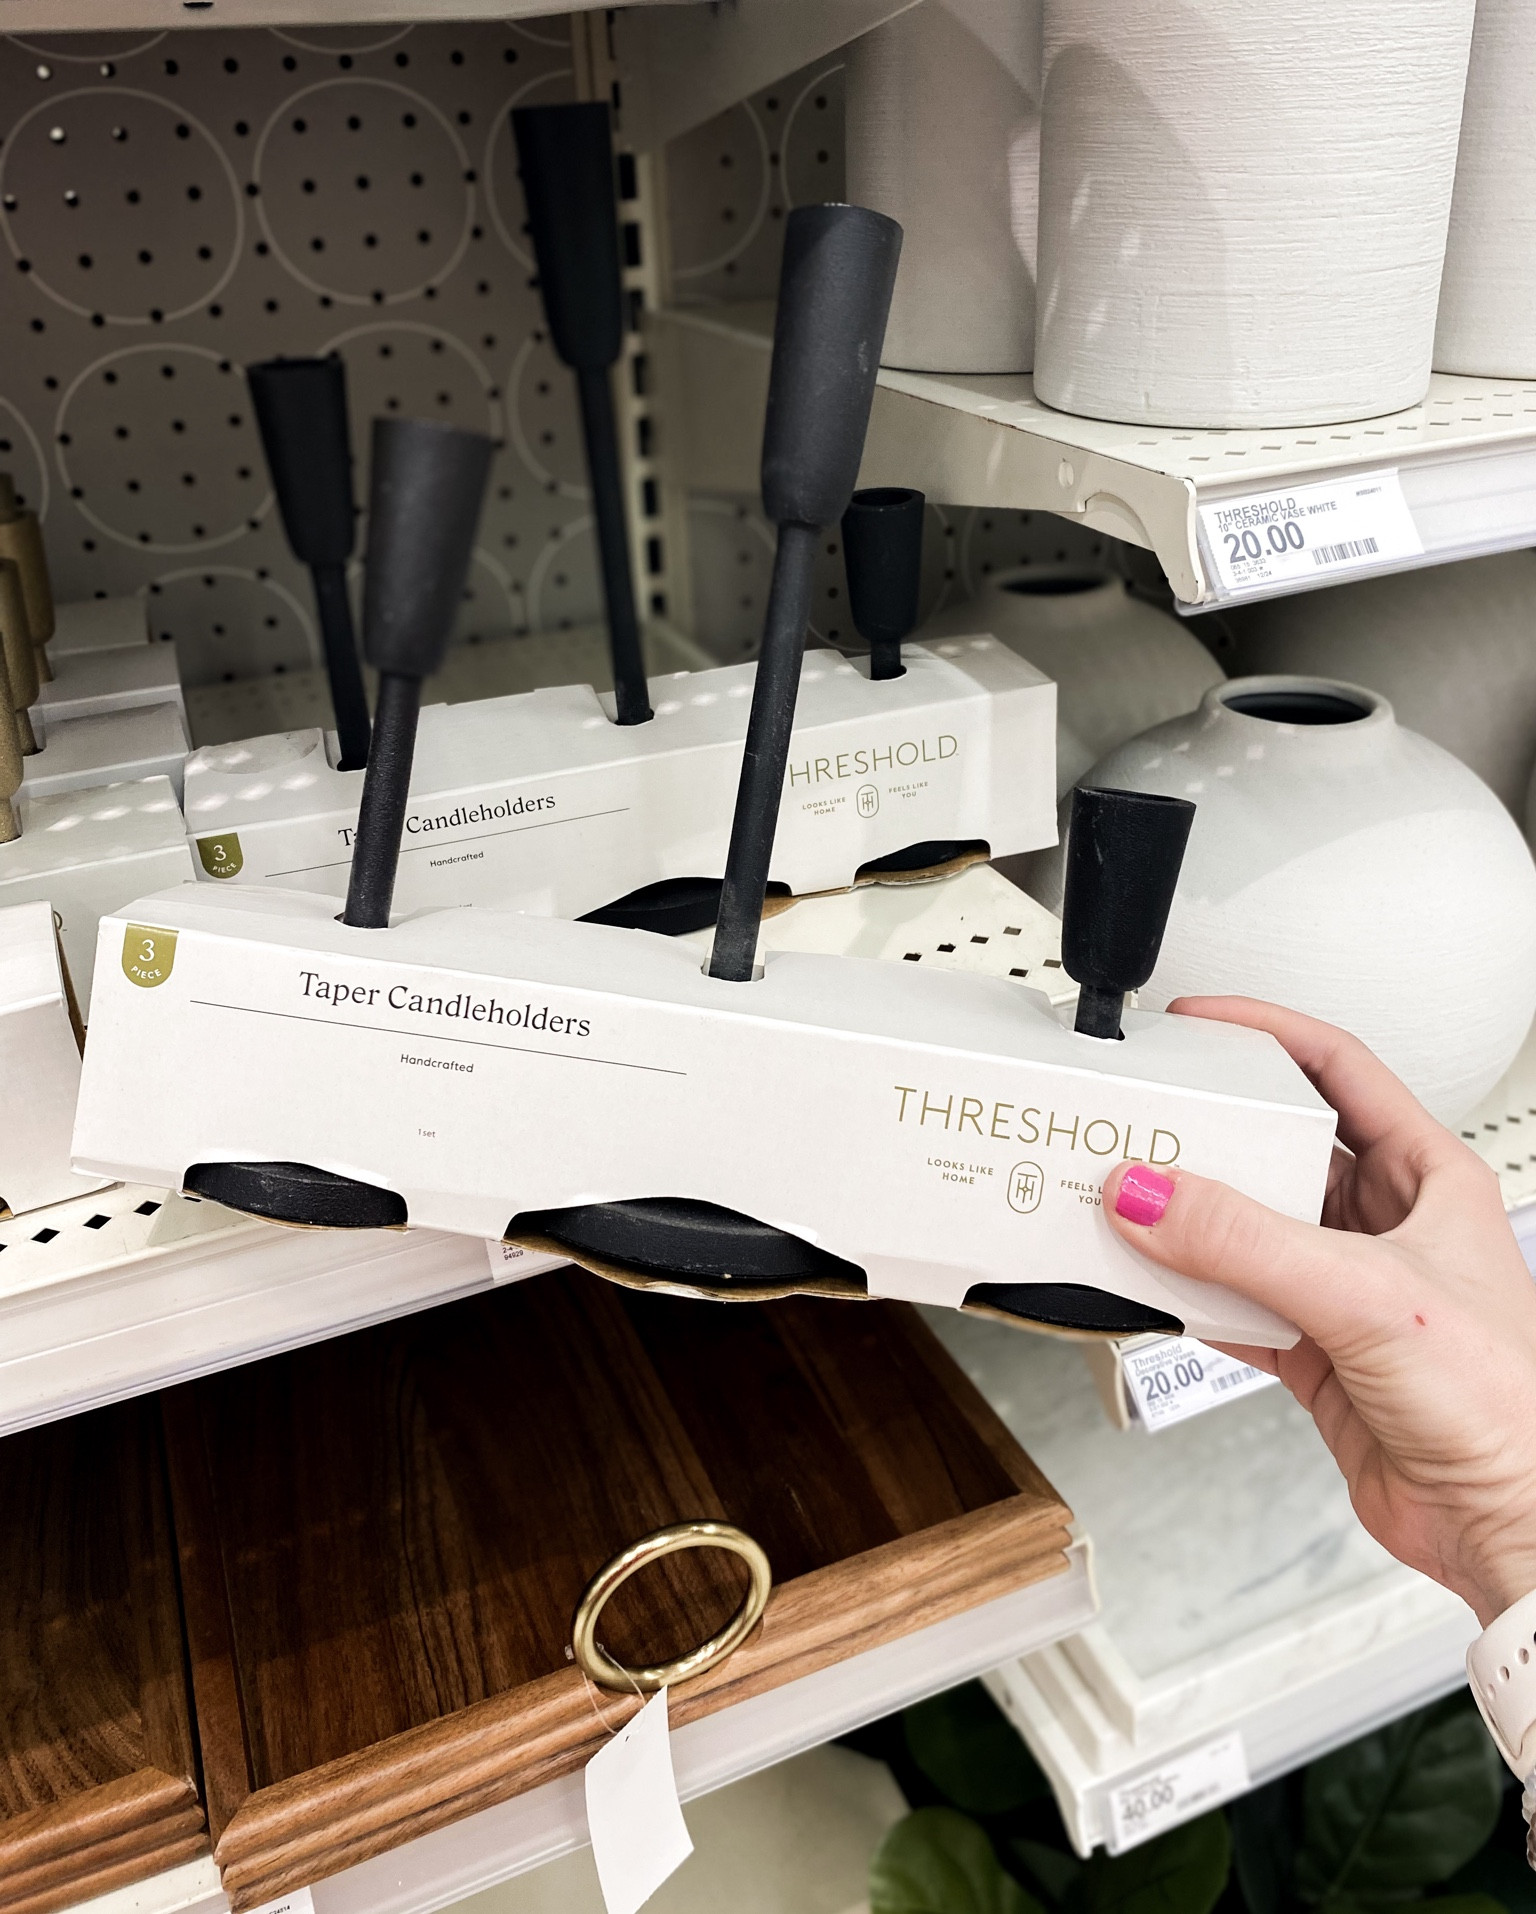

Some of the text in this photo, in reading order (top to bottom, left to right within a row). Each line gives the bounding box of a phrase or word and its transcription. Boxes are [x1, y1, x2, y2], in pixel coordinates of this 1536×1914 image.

[1214, 497, 1296, 524] THRESHOLD
[1235, 513, 1279, 530] CERAMIC
[1280, 507, 1306, 521] VASE
[1307, 501, 1338, 515] WHITE
[1223, 521, 1305, 564] 20.00
[789, 735, 958, 787] HRESHOLD
[888, 781, 929, 794] FEELS LIKE
[901, 791, 917, 799] YOU
[802, 796, 846, 810] LOOKS LIKE
[814, 806, 836, 816] HOME
[405, 794, 556, 834] Candleholders
[213, 844, 227, 861] 3
[429, 851, 484, 868] Handcrafted
[212, 862, 237, 874] PIECE
[138, 938, 155, 962] 3
[130, 965, 162, 979] PIECE
[299, 970, 591, 1037] Taper Candleholders
[400, 1054, 474, 1073] Handcrafted
[894, 1085, 1181, 1166] THRESHOLD
[927, 1157, 994, 1176] LOOKS LIKE
[942, 1172, 976, 1185] HOME
[1060, 1179, 1094, 1192] FEELS
[1079, 1194, 1102, 1206] YOU
[1132, 1344, 1182, 1368] Threshold
[1140, 1357, 1204, 1402] 20.00
